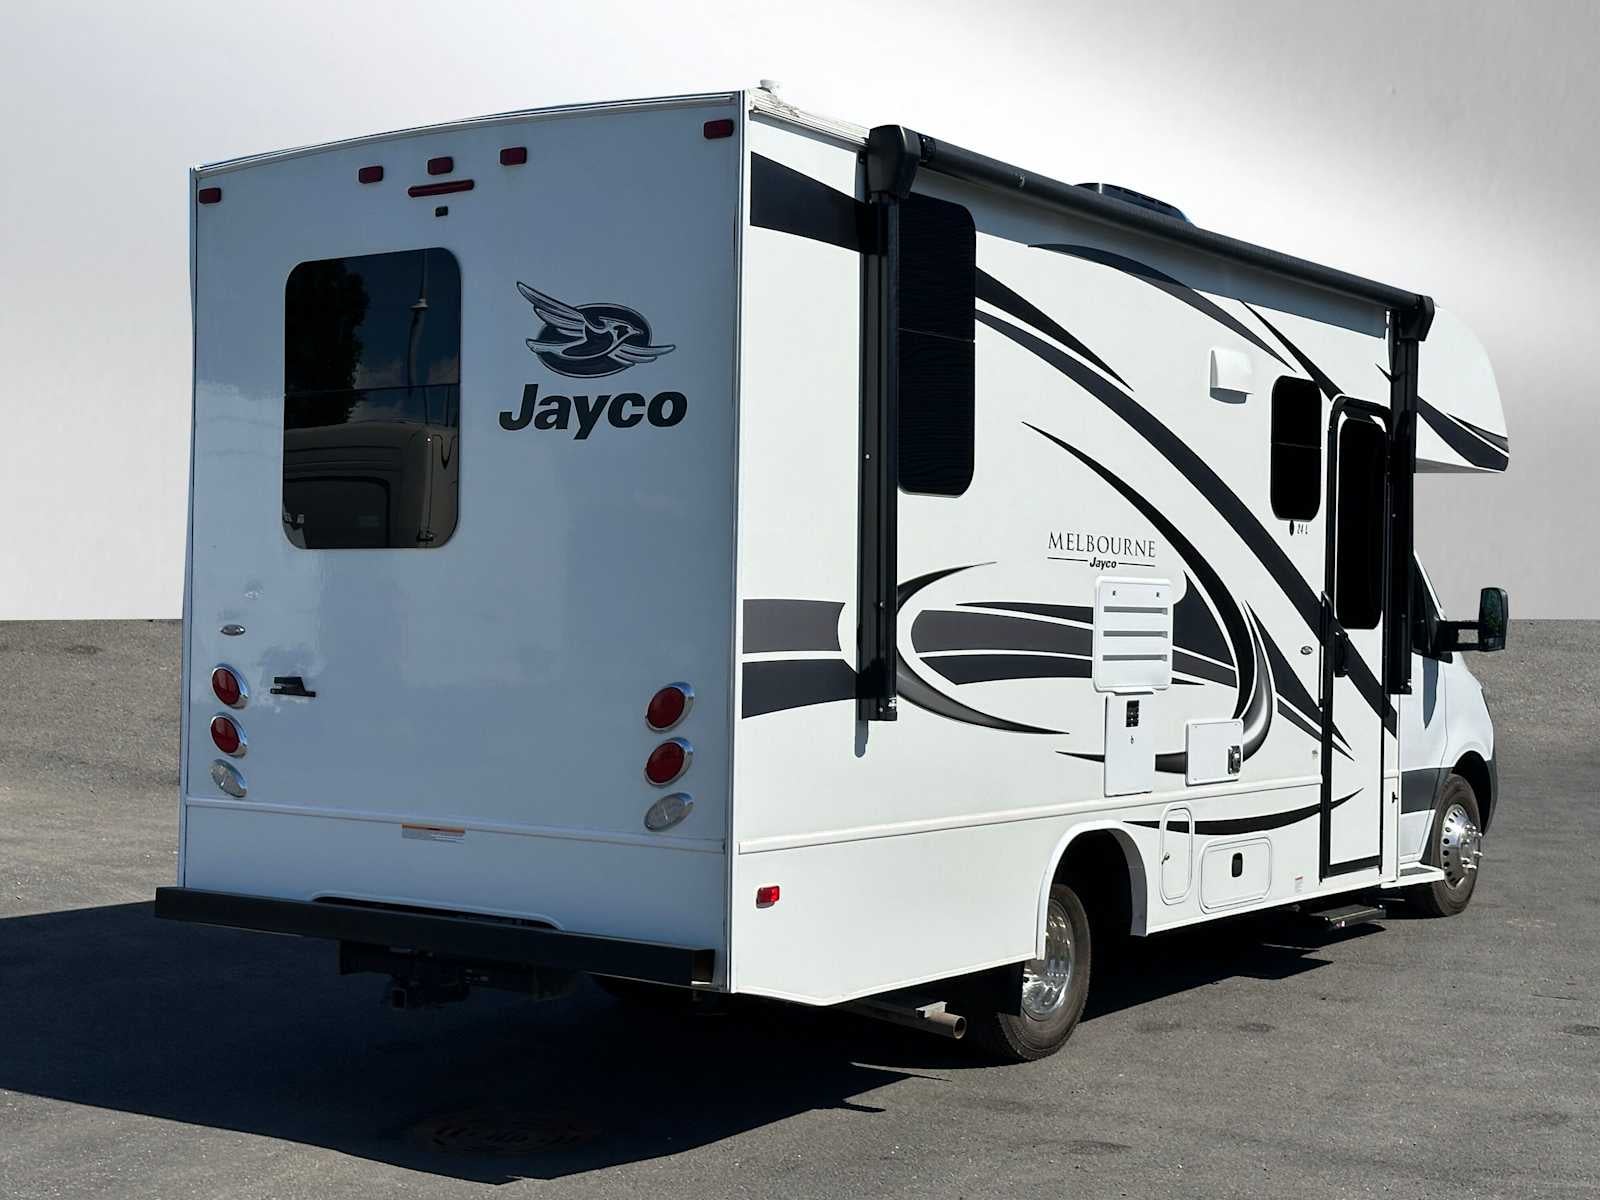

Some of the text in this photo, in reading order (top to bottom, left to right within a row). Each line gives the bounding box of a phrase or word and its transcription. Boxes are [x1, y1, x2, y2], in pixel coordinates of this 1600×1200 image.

[499, 383, 688, 440] Jayco
[1048, 531, 1156, 558] MELBOURNE
[1089, 557, 1117, 570] Jayco
